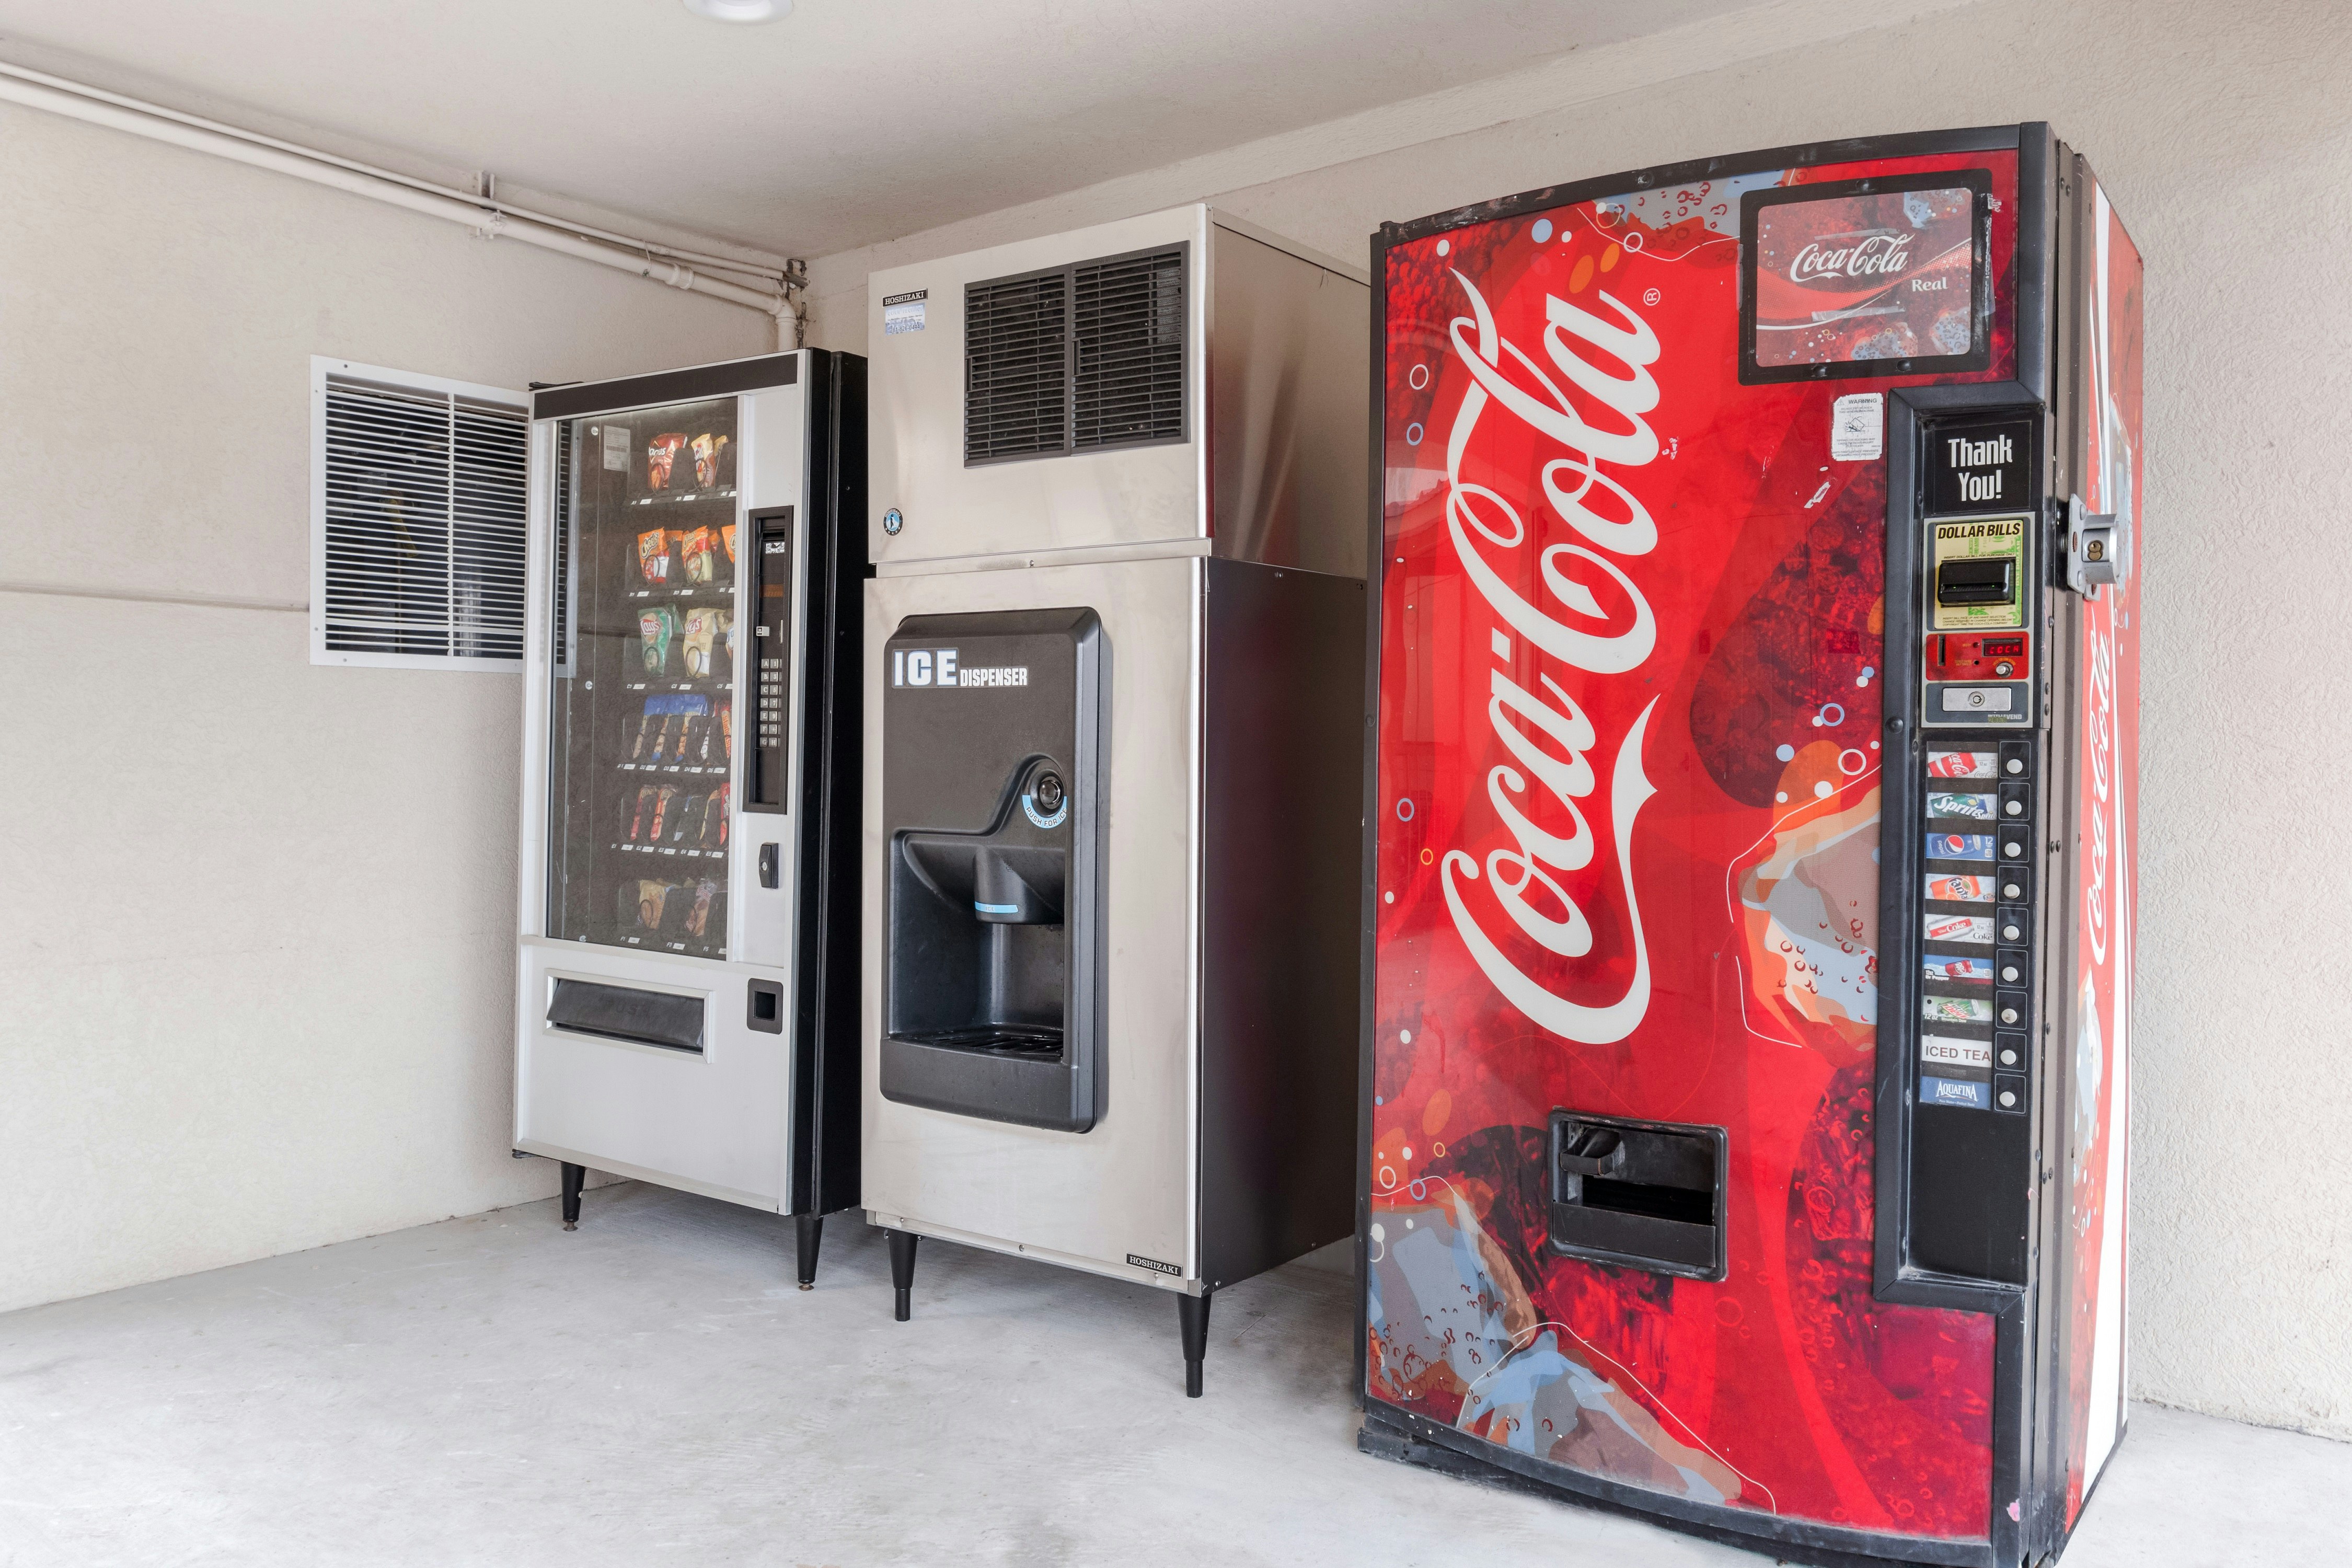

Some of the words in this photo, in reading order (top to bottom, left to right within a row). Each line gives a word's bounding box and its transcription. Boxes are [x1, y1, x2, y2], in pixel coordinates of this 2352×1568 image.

[1790, 233, 1915, 282] Coca-Cola
[1911, 277, 1949, 292] Real
[885, 292, 924, 305] HOSHIZAKI
[1948, 434, 2012, 467] Thank
[1958, 469, 2001, 501] You!
[1938, 525, 1985, 539] DOLLAR
[1987, 523, 2021, 537] BILLS
[1441, 267, 1661, 1044] Coca-Cola
[894, 650, 957, 686] ICE
[960, 668, 1028, 686] DISPENSER
[2088, 605, 2109, 965] Coca-Cola
[1026, 807, 1042, 825] PUSH
[1058, 808, 1067, 821] ICE
[1934, 796, 1984, 817] Sprite
[1946, 922, 1966, 932] Coke
[1926, 1046, 1958, 1058] ICED
[1963, 1049, 1991, 1062] TEA
[1935, 1080, 1978, 1102] AQUAFINA
[1129, 1256, 1178, 1274] HOSHIZAKI
